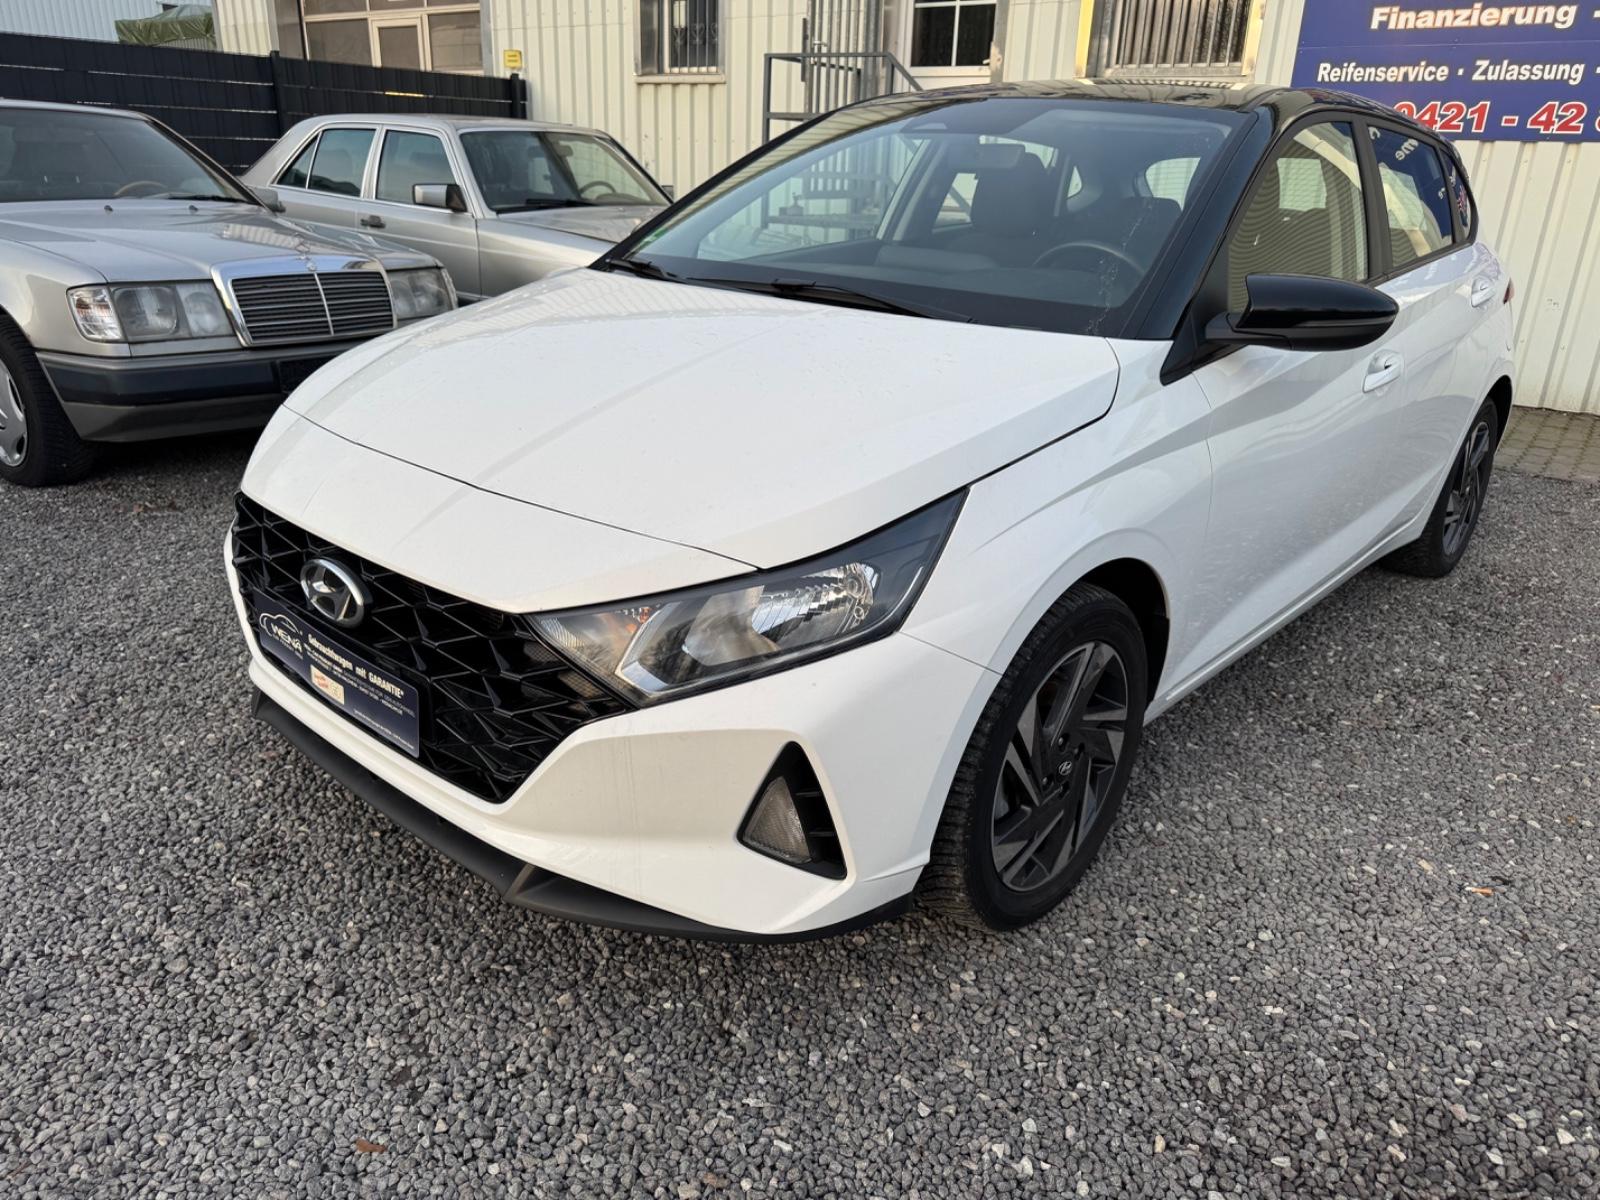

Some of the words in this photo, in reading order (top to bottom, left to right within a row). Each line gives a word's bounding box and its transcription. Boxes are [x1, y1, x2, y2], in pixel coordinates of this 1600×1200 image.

[1370, 3, 1578, 30] Finanzierung
[1317, 61, 1450, 83] Reifenservice
[1471, 59, 1586, 86] Zulassung
[1526, 101, 1587, 134] 42
